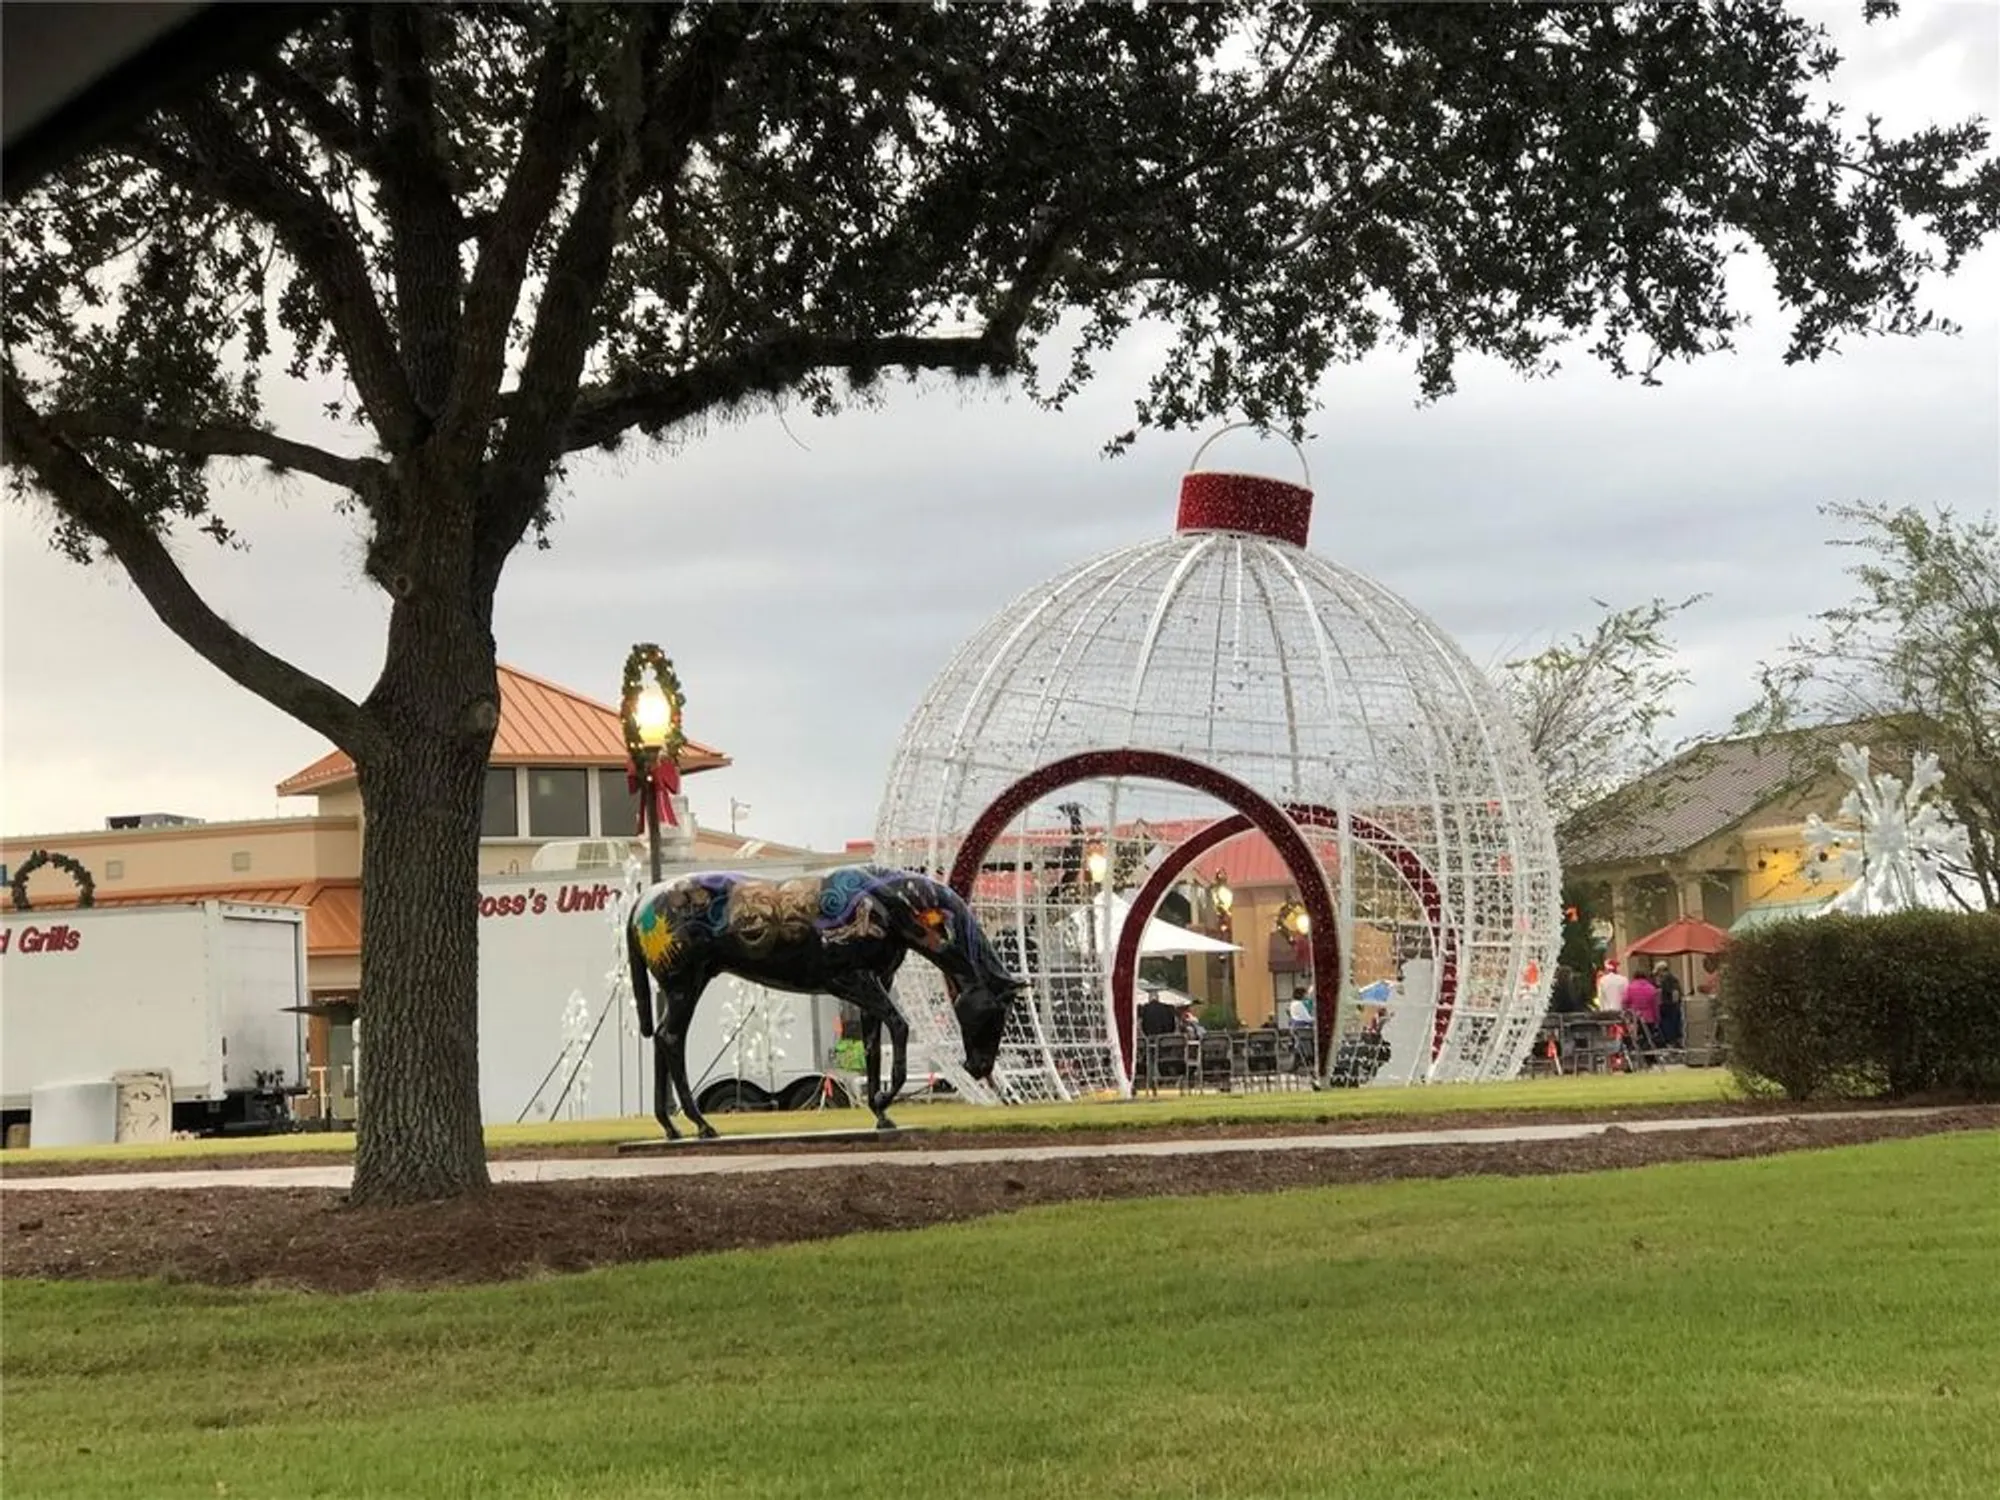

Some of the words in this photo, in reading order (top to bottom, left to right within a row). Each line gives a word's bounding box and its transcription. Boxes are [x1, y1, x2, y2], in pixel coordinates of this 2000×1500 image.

[478, 887, 547, 917] oss's
[556, 882, 641, 913] Unit
[18, 925, 81, 954] Grills
